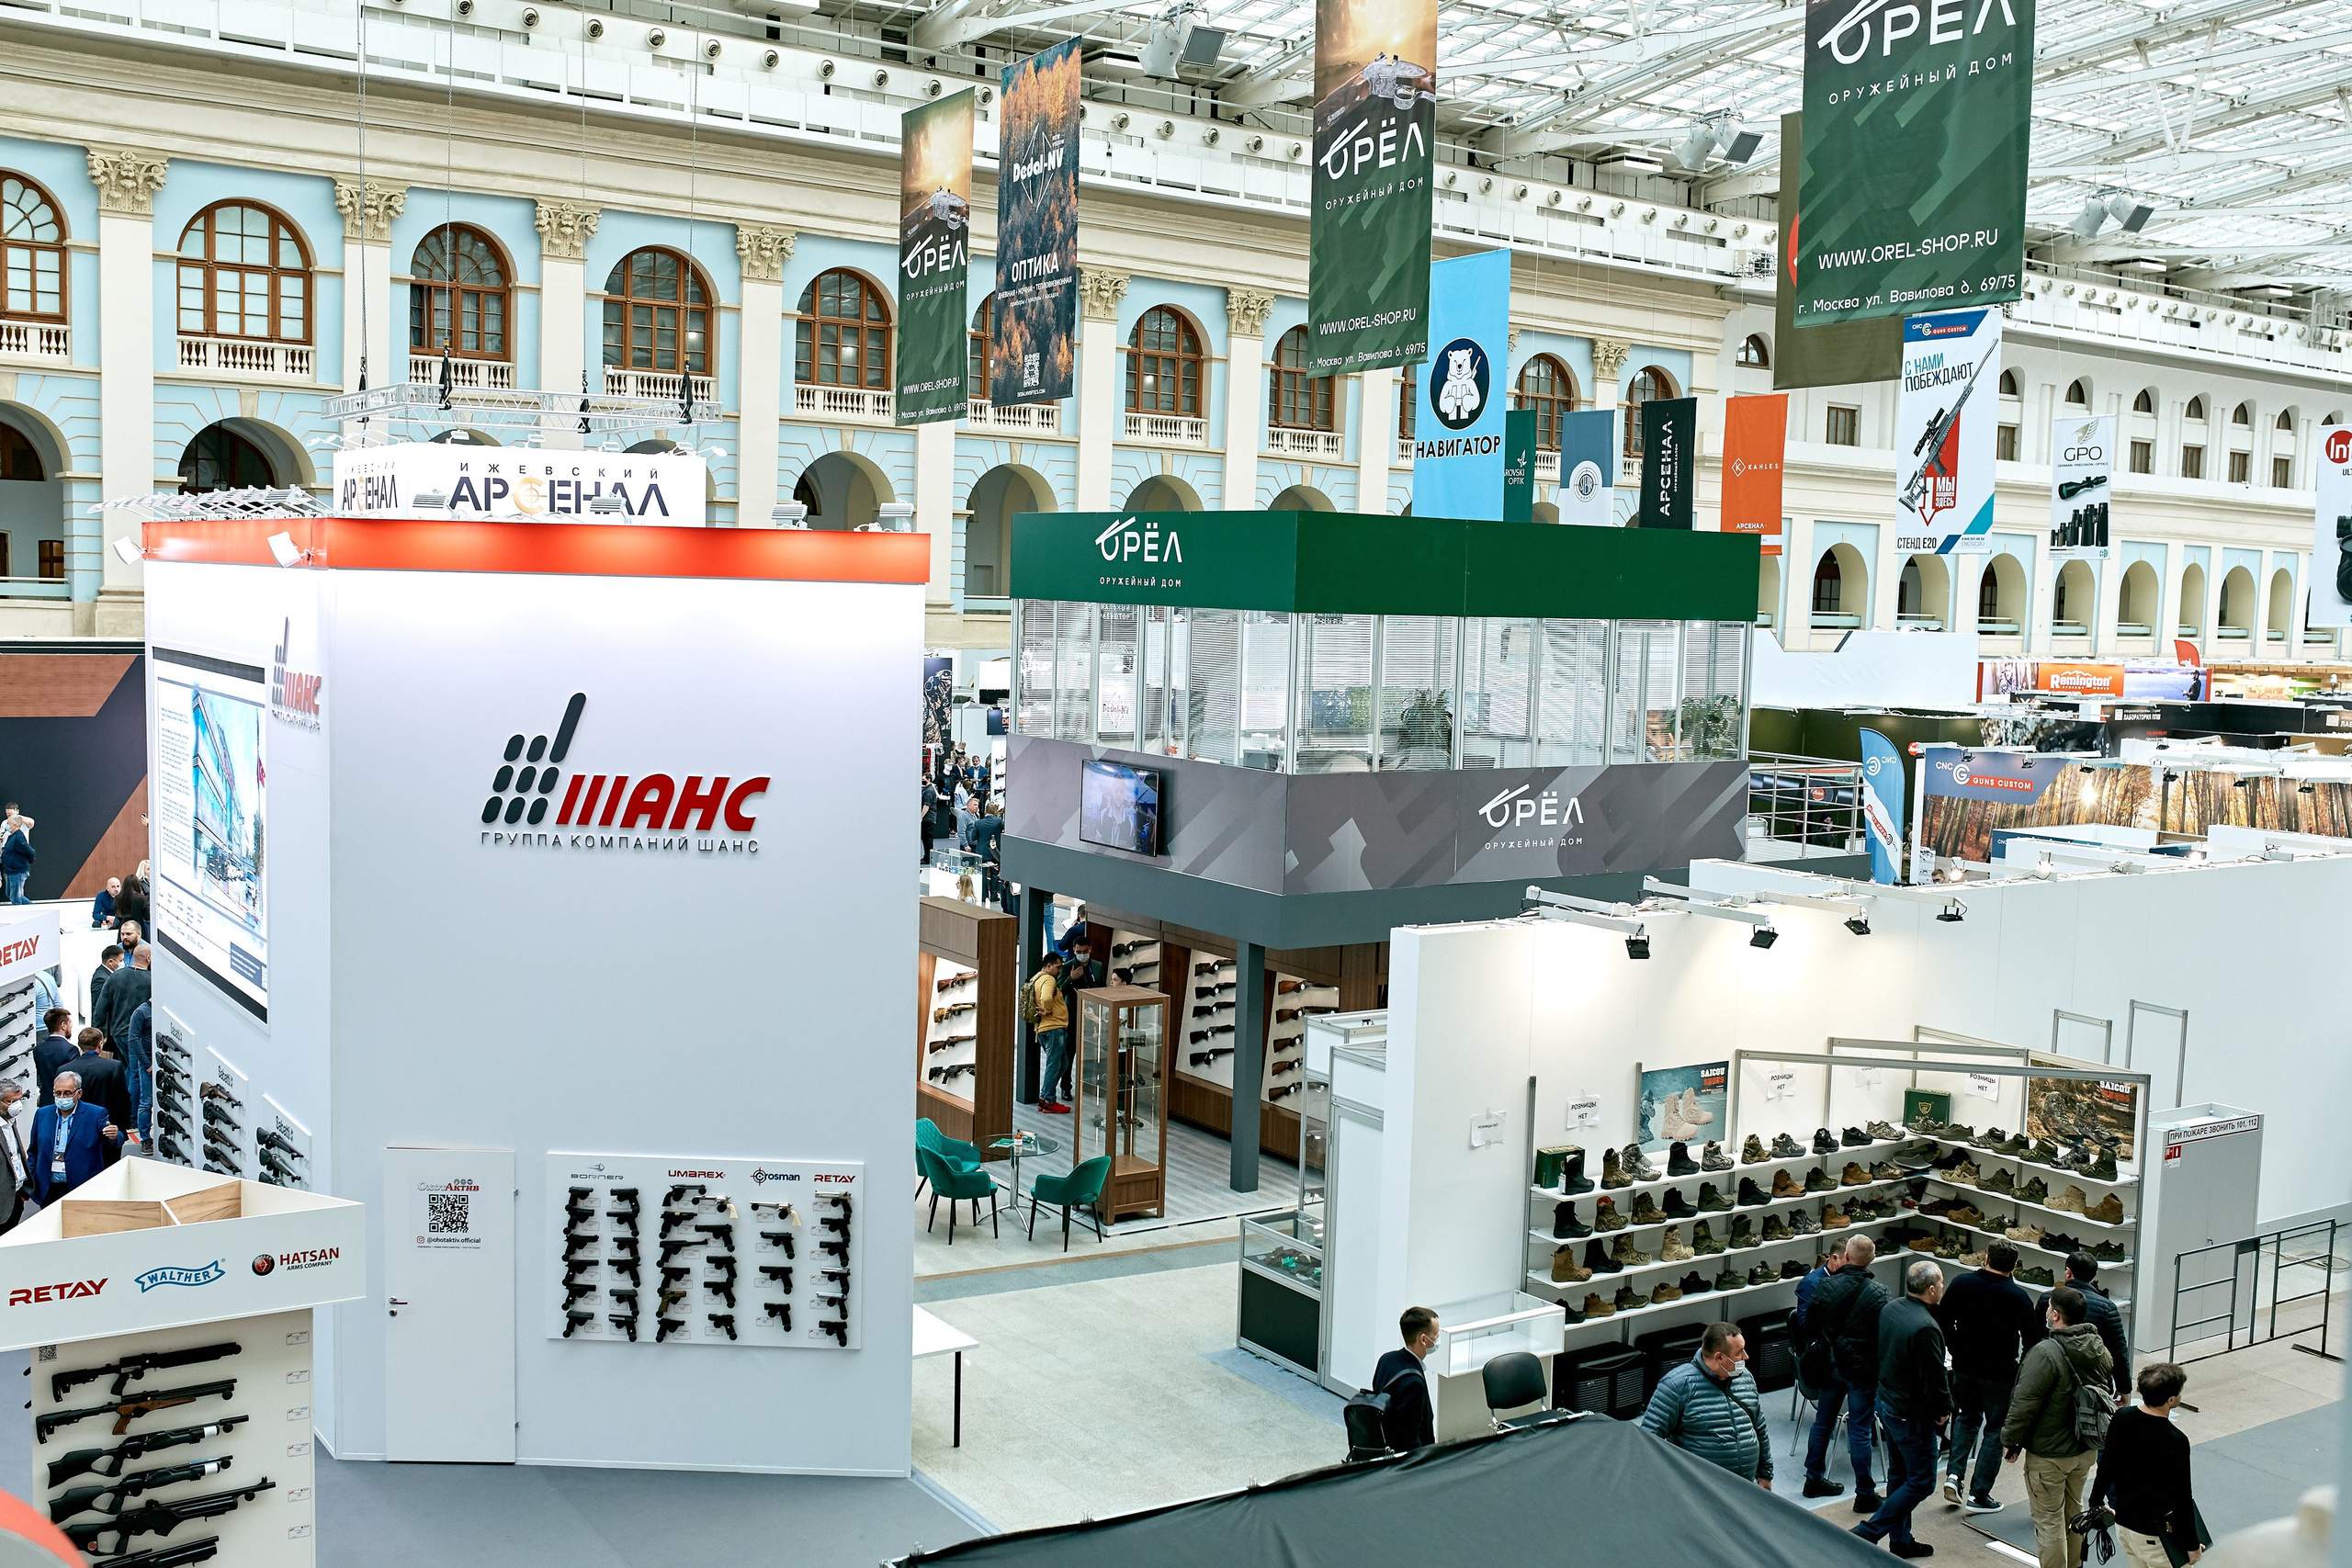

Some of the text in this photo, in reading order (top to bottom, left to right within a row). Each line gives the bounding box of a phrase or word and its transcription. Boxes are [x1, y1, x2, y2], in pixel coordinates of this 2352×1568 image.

[1828, 52, 2012, 105] ОРУЖЕЙНЫЙ ДОМ
[1318, 118, 1425, 180] ОРЁЛ
[1012, 148, 1064, 183] Dedal-NV
[1325, 177, 1423, 210] ОРУЖЕЙНЫЙ ДОМ
[901, 233, 966, 279] ОРЁЛ
[1818, 228, 1998, 270] WWW.OREL-SHOP.RU
[1012, 252, 1059, 283] ОПТИКА
[906, 279, 965, 300] ОРУЖЕЙНЫЙ ДОМ
[1798, 274, 2016, 314] г. Москва ул. Вавилова д. 69/75
[1319, 308, 1417, 335] WWW.OREL-SHOP.RU
[1309, 341, 1426, 368] г. Москва ул. Вавилова д. 69/75
[1914, 352, 1944, 375] НАМИ
[903, 377, 960, 395] WWW.OREL-SHOP.RU
[1905, 362, 1973, 392] ПОБЕЖДАЮТ
[901, 410, 917, 420] Москва
[926, 406, 947, 416] Вавилова
[954, 402, 967, 412] 69/75
[1415, 434, 1501, 459] НАВИГАТОР
[2064, 446, 2102, 461] GPO
[460, 461, 659, 479] ИЖЕВСКИЙ
[1505, 468, 1525, 477] ROVSKI
[1659, 420, 1673, 516] АРСЕНАЛ
[1508, 477, 1525, 485] OPTIK
[1936, 477, 1955, 491] МЫ
[342, 474, 398, 511] АРСЕНАЛ
[449, 475, 670, 516] АРСЕНАЛ
[1935, 496, 1954, 508] ЗДЕСЬ
[1094, 515, 1183, 562] ОРЁЛ
[1897, 536, 1920, 549] СТЕНД
[1100, 575, 1182, 588] ОРУЖЕЙНЫЙ ДОМ
[2050, 673, 2110, 689] Remington
[283, 671, 322, 716] ШАНС
[1936, 761, 1953, 770] CNC
[1973, 777, 1995, 786] GUNS
[1997, 779, 2031, 790] CUSTOM
[555, 773, 771, 832] ШАНС
[1477, 784, 1584, 829] ОРЁЛ
[481, 831, 759, 853] ГРУППА КОМПАНИЙ ШАНС
[1485, 837, 1583, 851] ОРУЖЕЙНЫЙ ДОМ
[1701, 1067, 1725, 1077] SAICOU
[1770, 1073, 1793, 1081] РОЗНИЦЫ
[1970, 1072, 1996, 1084] РОЗНИЦЫ
[1977, 1084, 1988, 1092] НЕТ
[2099, 1080, 2131, 1094] SAICOU
[1570, 1101, 1597, 1111] РОЗНИЦЫ
[2170, 1133, 2182, 1141] ПРИ
[2183, 1127, 2208, 1138] ПОЖАРЕ
[2209, 1122, 2235, 1134] ЗВОНИТЬ
[2248, 1118, 2257, 1126] 112
[814, 1175, 856, 1183] RETAY
[279, 1247, 339, 1266] HATSAN
[304, 1260, 333, 1269] COMPANY
[147, 1269, 211, 1283] WALTHER
[9, 1277, 108, 1307] RETAY
